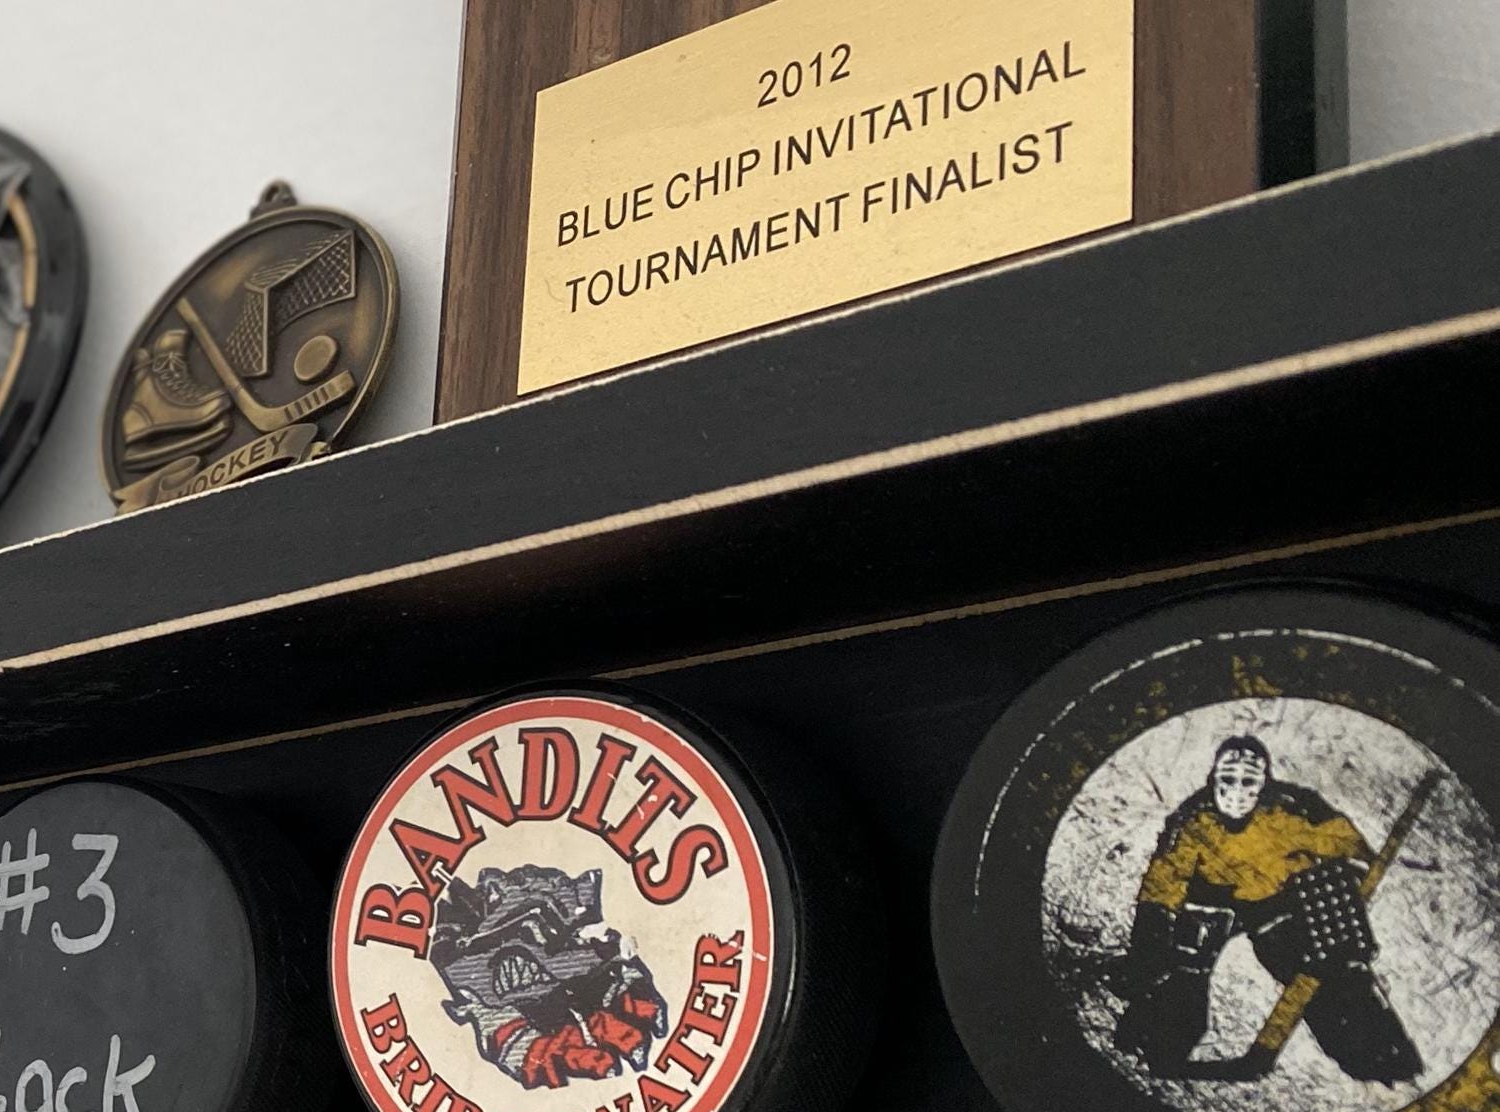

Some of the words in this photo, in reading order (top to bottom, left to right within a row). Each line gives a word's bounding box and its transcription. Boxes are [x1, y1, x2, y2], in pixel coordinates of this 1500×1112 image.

[556, 182, 654, 246] BLUE
[665, 148, 761, 210] CHIP
[772, 41, 1087, 178] INVITATIONAL
[757, 42, 852, 108] 2012
[566, 192, 851, 313] TOURNAMENT
[862, 121, 1073, 224] FINALIST
[355, 727, 729, 960] BANDITS
